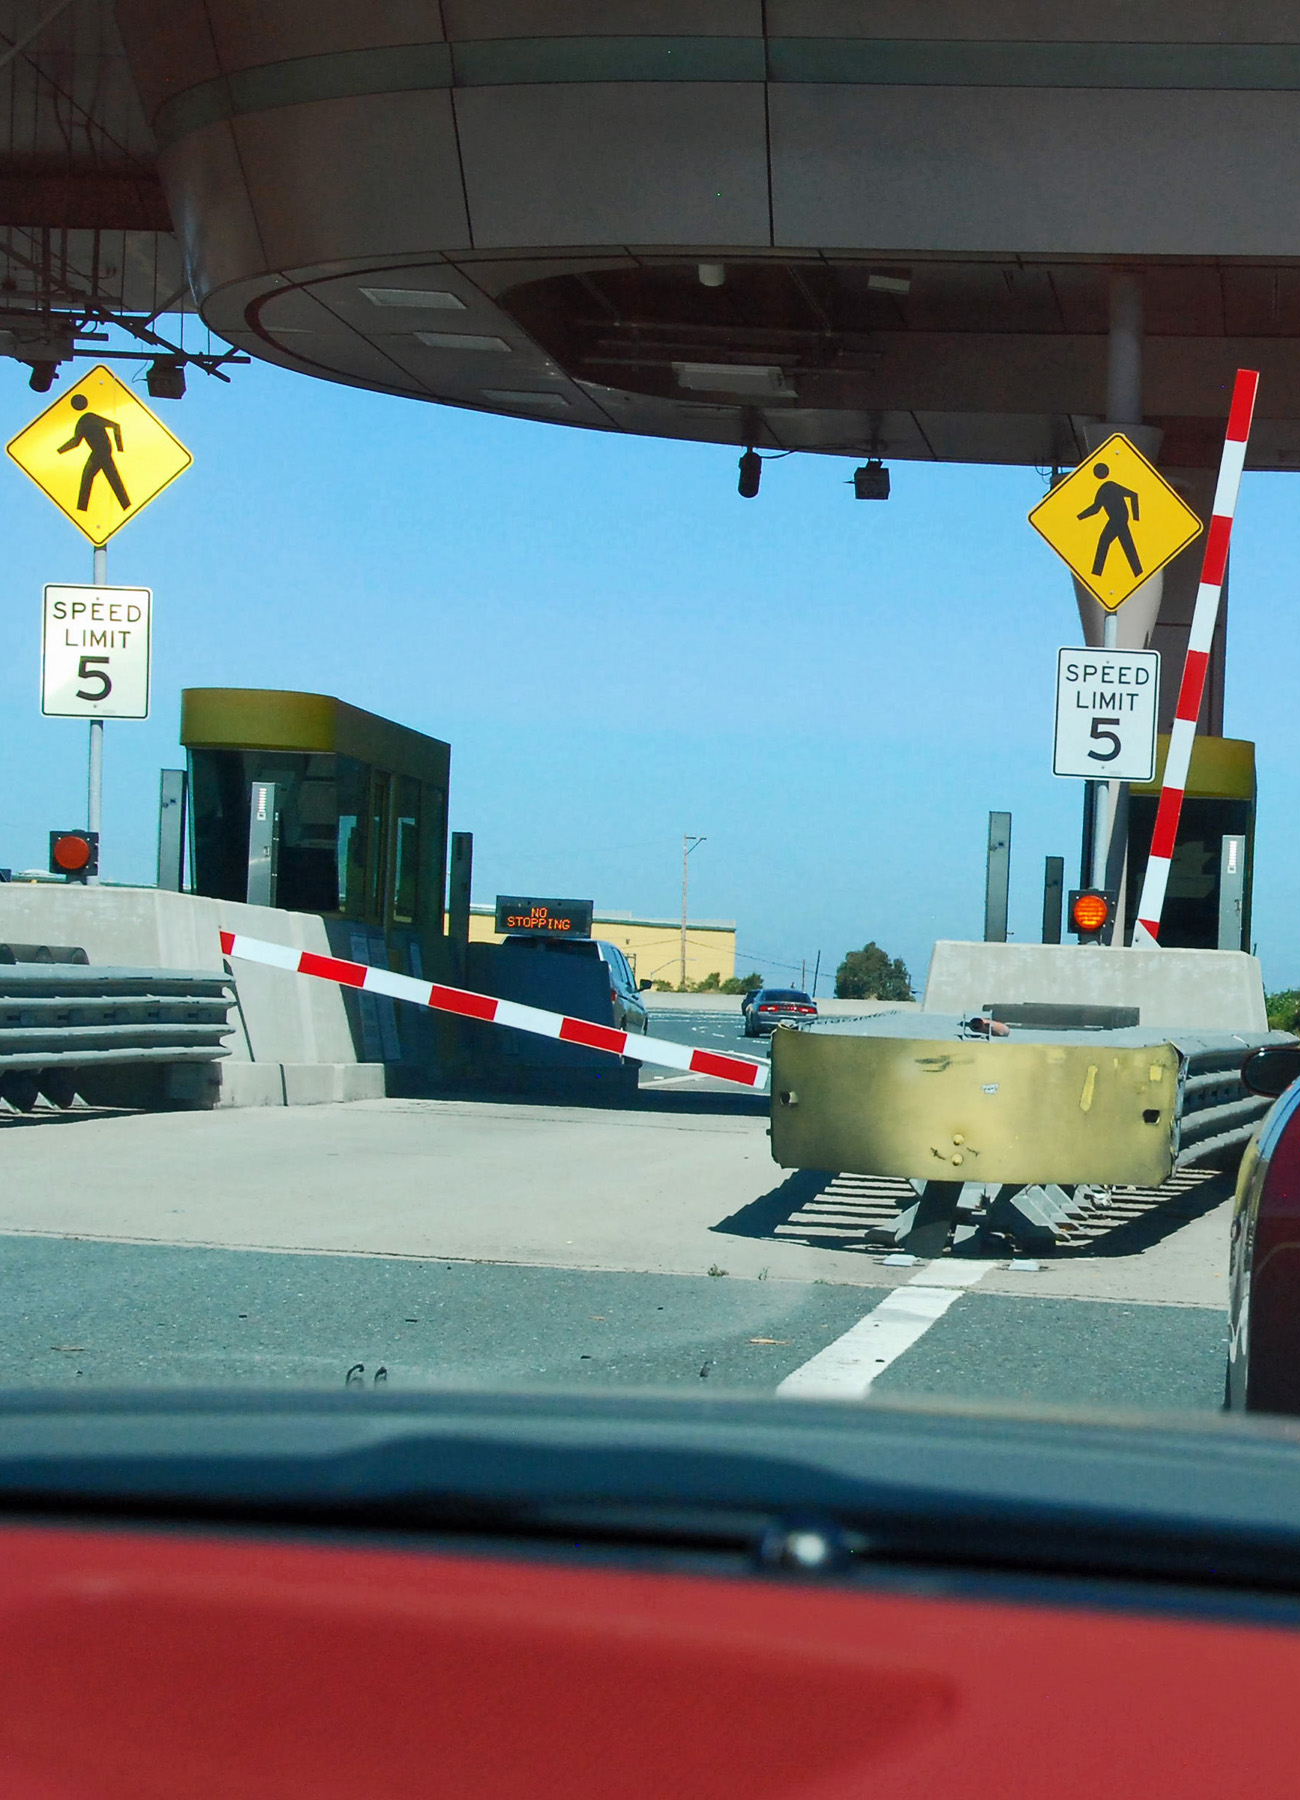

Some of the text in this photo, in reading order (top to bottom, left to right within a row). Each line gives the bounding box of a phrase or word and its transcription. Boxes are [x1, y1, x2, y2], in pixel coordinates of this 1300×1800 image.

[53, 601, 141, 622] SPEED
[65, 628, 131, 648] LIMIT
[75, 655, 112, 701] 5
[1065, 663, 1149, 685] SPEED
[1076, 690, 1139, 711] LIMIT
[1087, 717, 1121, 762] 5
[506, 916, 571, 930] STOPPING
[530, 907, 548, 918] NO
